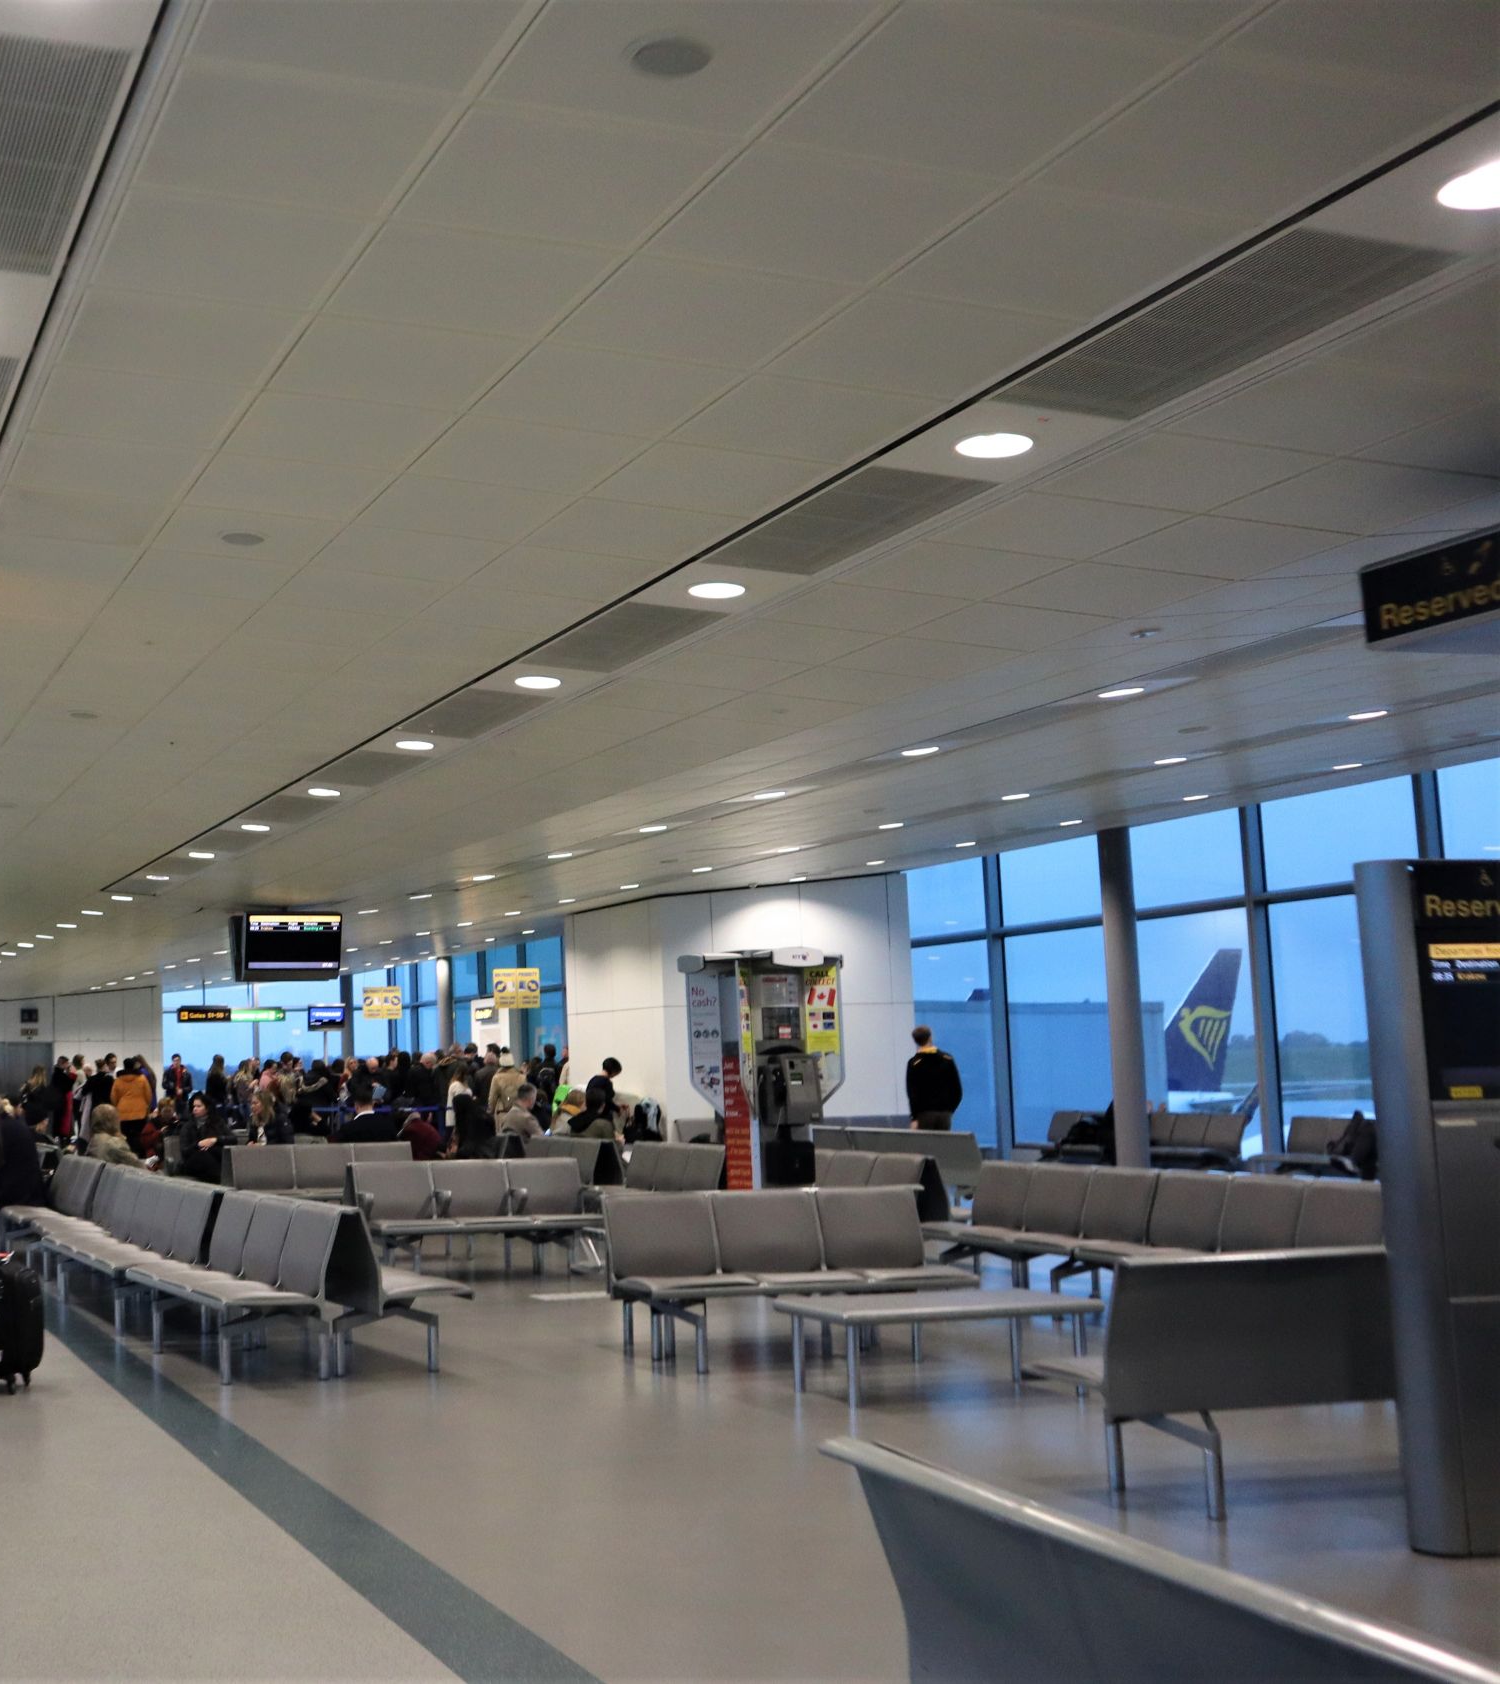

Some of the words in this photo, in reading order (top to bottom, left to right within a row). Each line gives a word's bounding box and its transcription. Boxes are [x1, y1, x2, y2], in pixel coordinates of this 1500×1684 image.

[810, 970, 829, 978] CALL
[805, 977, 836, 987] COLLECT
[691, 987, 705, 996] No
[691, 997, 717, 1007] cash?
